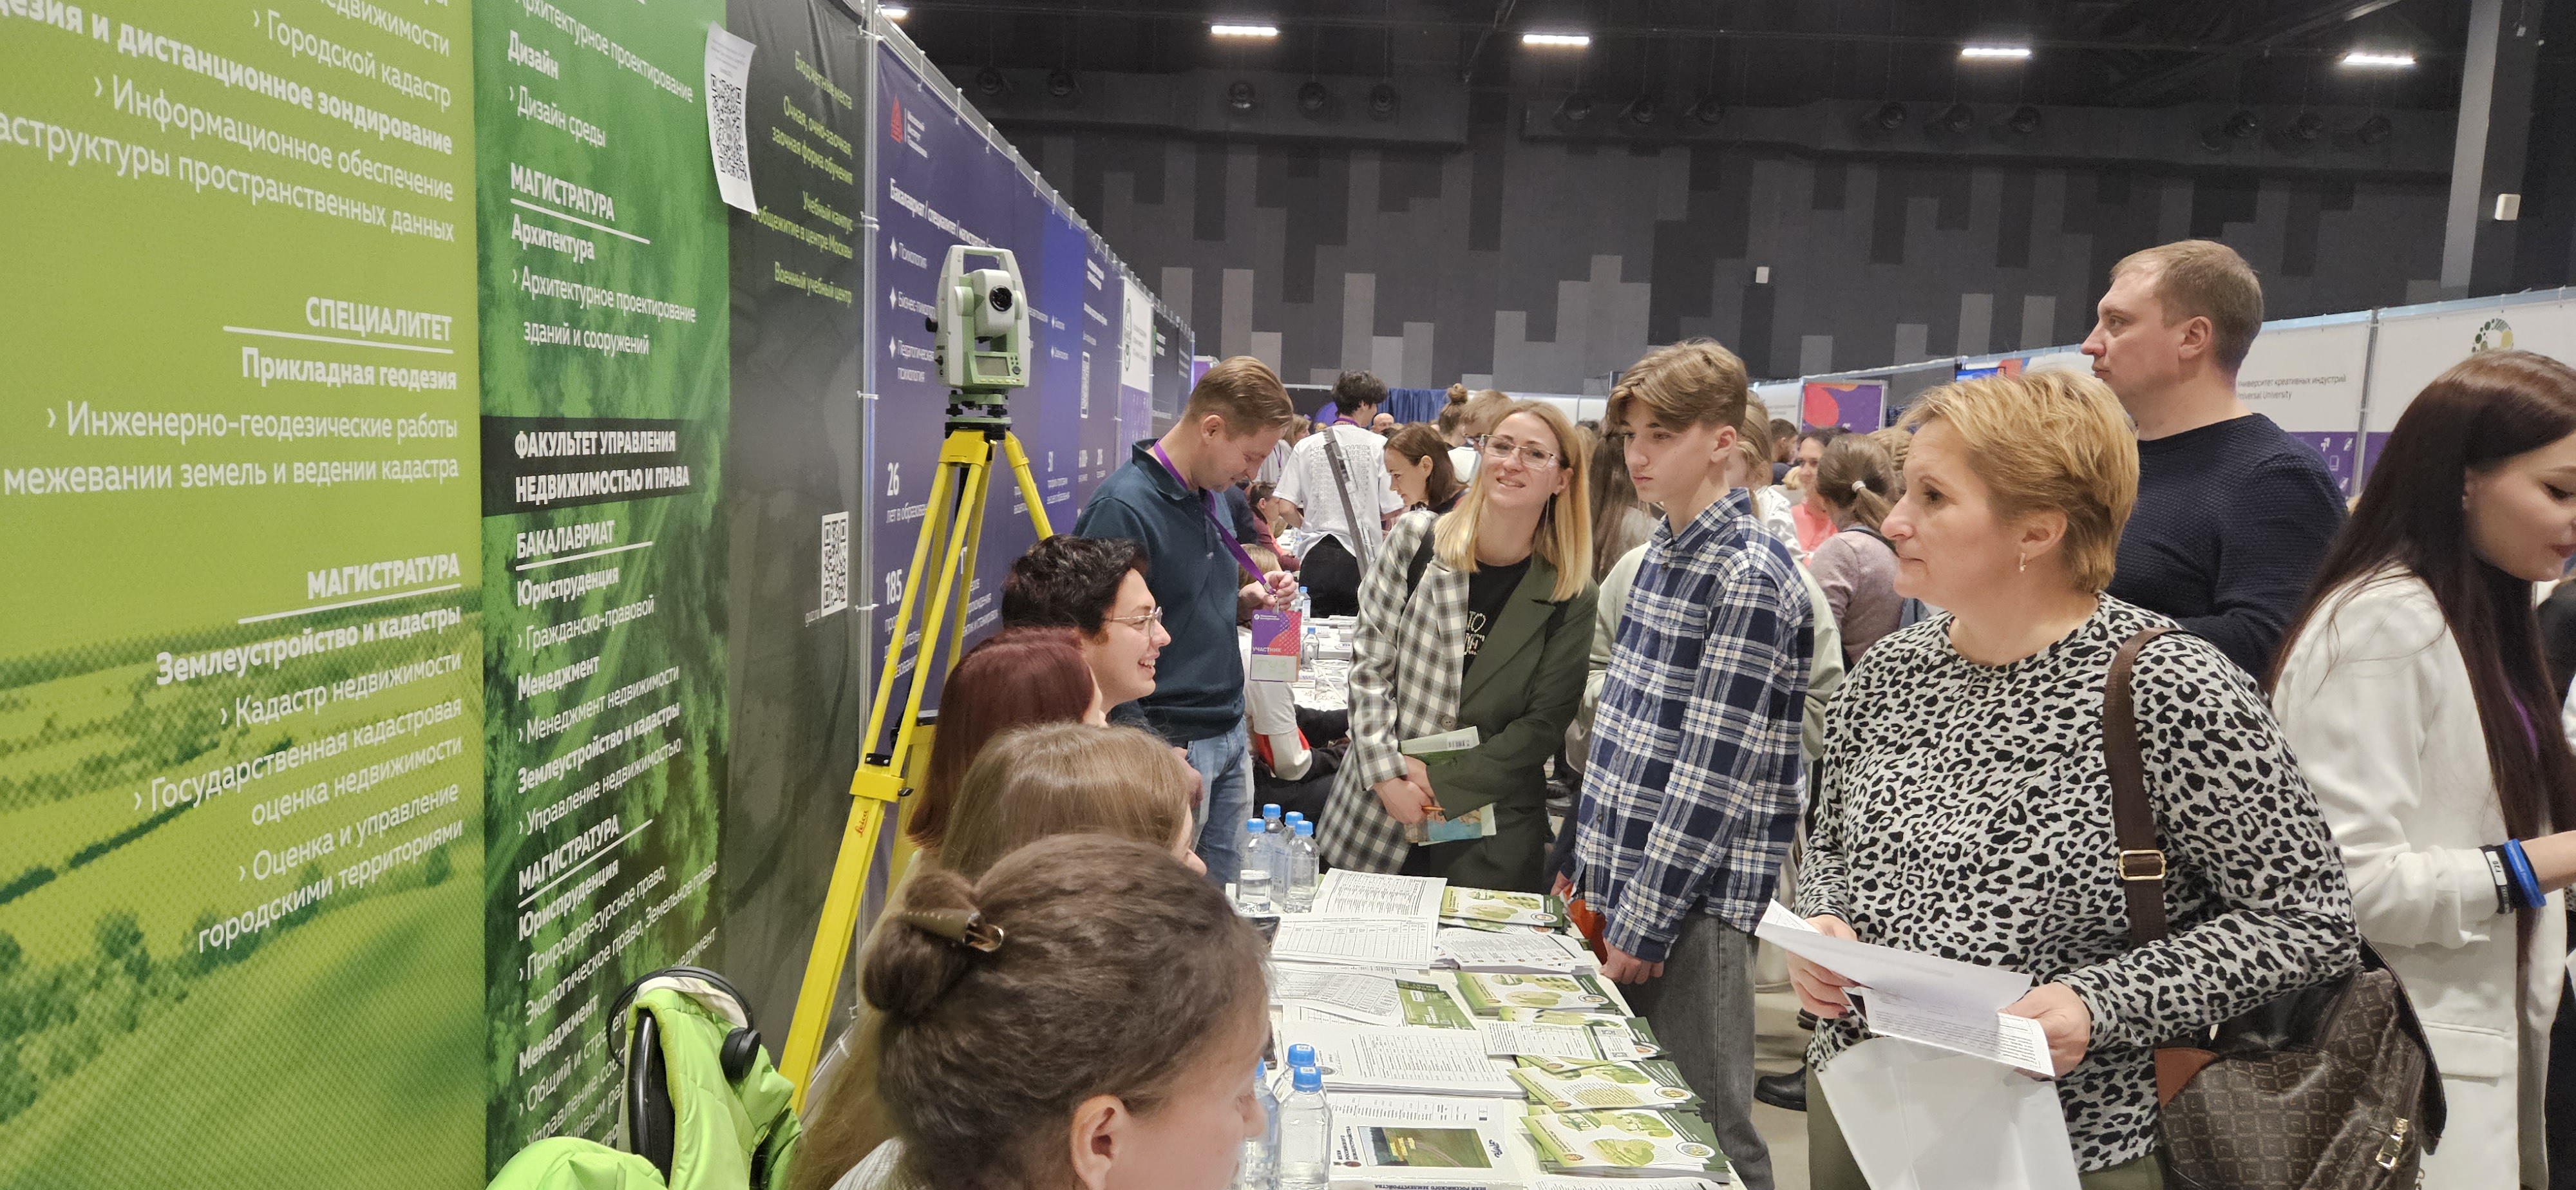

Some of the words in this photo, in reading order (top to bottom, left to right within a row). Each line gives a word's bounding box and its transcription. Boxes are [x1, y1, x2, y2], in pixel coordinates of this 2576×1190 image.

[268, 9, 375, 79] Городской
[381, 63, 451, 113] кадастр
[507, 30, 559, 80] Дизайн
[515, 0, 609, 55] рхитектурное
[611, 42, 694, 103] проектирование
[91, 12, 109, 44] и
[117, 23, 313, 109] дистанционное
[317, 91, 452, 155] зондирование
[783, 95, 808, 131] Очная,
[113, 73, 332, 168] Информационное
[338, 149, 453, 202] обеспечение
[517, 85, 566, 130] Дизайн
[569, 116, 606, 148] среды
[772, 126, 801, 156] заочная
[801, 140, 824, 169] форма
[824, 156, 853, 185] обучения
[178, 155, 386, 227] пространственных
[391, 208, 455, 242] данных
[510, 162, 615, 222] МАГИСТРАТУРА
[802, 191, 831, 222] Учебный
[511, 213, 595, 264] Архитектура
[757, 205, 800, 239] общежитие
[805, 229, 828, 252] центре
[520, 265, 614, 310] Архитектурное
[616, 292, 696, 323] проектирование
[774, 261, 806, 289] Военный
[806, 277, 835, 296] учебный
[835, 287, 852, 308] центр
[305, 296, 452, 341] СПЕЦИАЛИТЕТ
[523, 321, 571, 346] зданий
[573, 329, 581, 346] и
[583, 330, 650, 358] сооружений
[242, 346, 375, 387] Прикладная
[379, 366, 457, 392] геодезия
[67, 400, 392, 446] Инженерно-геодезические
[397, 412, 458, 445] работы
[515, 430, 599, 459] ФАКУЛЬТЕТ
[600, 431, 676, 455] УПРАВЛЕНИЯ
[4, 464, 172, 495] межевании
[180, 461, 267, 489] земель
[273, 462, 287, 484] и
[293, 459, 377, 487] ведении
[382, 458, 459, 485] кадастра
[515, 468, 643, 505] НЕДВИЖИМОСТЬЮ
[645, 468, 653, 490] И
[655, 465, 690, 489] ПРАВА
[887, 462, 900, 496] 26
[516, 520, 616, 559] БАКАЛАВРИАТ
[307, 552, 460, 600] МАГИСТРАТУРА
[516, 567, 619, 610] Юриспруденция
[886, 569, 902, 605] 185
[156, 625, 358, 686] Землеустройство
[363, 625, 374, 643] и
[379, 606, 460, 641] кадастры
[526, 594, 654, 656] Гражданско-правовой
[235, 685, 327, 727] Кадастр
[332, 652, 461, 701] недвижимости
[518, 656, 600, 701] Менеджмент
[527, 695, 605, 744] Менеджмент
[607, 665, 679, 710] недвижимости
[151, 732, 348, 812] Государственная
[353, 698, 462, 750] кадастровая
[518, 728, 623, 794] Землеустройство
[625, 726, 632, 741] и
[633, 702, 680, 737] кадастры
[251, 781, 329, 826] оценка
[334, 736, 462, 798] недвижимости
[526, 780, 601, 836] Управление
[602, 737, 681, 794] недвижимостью
[252, 833, 334, 881] Оценка
[340, 826, 351, 842] и
[355, 783, 459, 848] управление
[518, 814, 620, 896] МАГИСТРАТУРА
[198, 874, 333, 954] городскими
[337, 819, 462, 891] территориями
[518, 858, 619, 941] Юриспруденция
[524, 948, 611, 1026] Экологическое
[612, 921, 645, 958] право,
[645, 881, 692, 929] Земельное
[692, 860, 717, 894] право
[527, 886, 635, 981] Природоресурсное
[636, 865, 666, 900] право,
[518, 993, 599, 1077] Менеджмент
[527, 1055, 571, 1112] Общий
[574, 1049, 582, 1070] и
